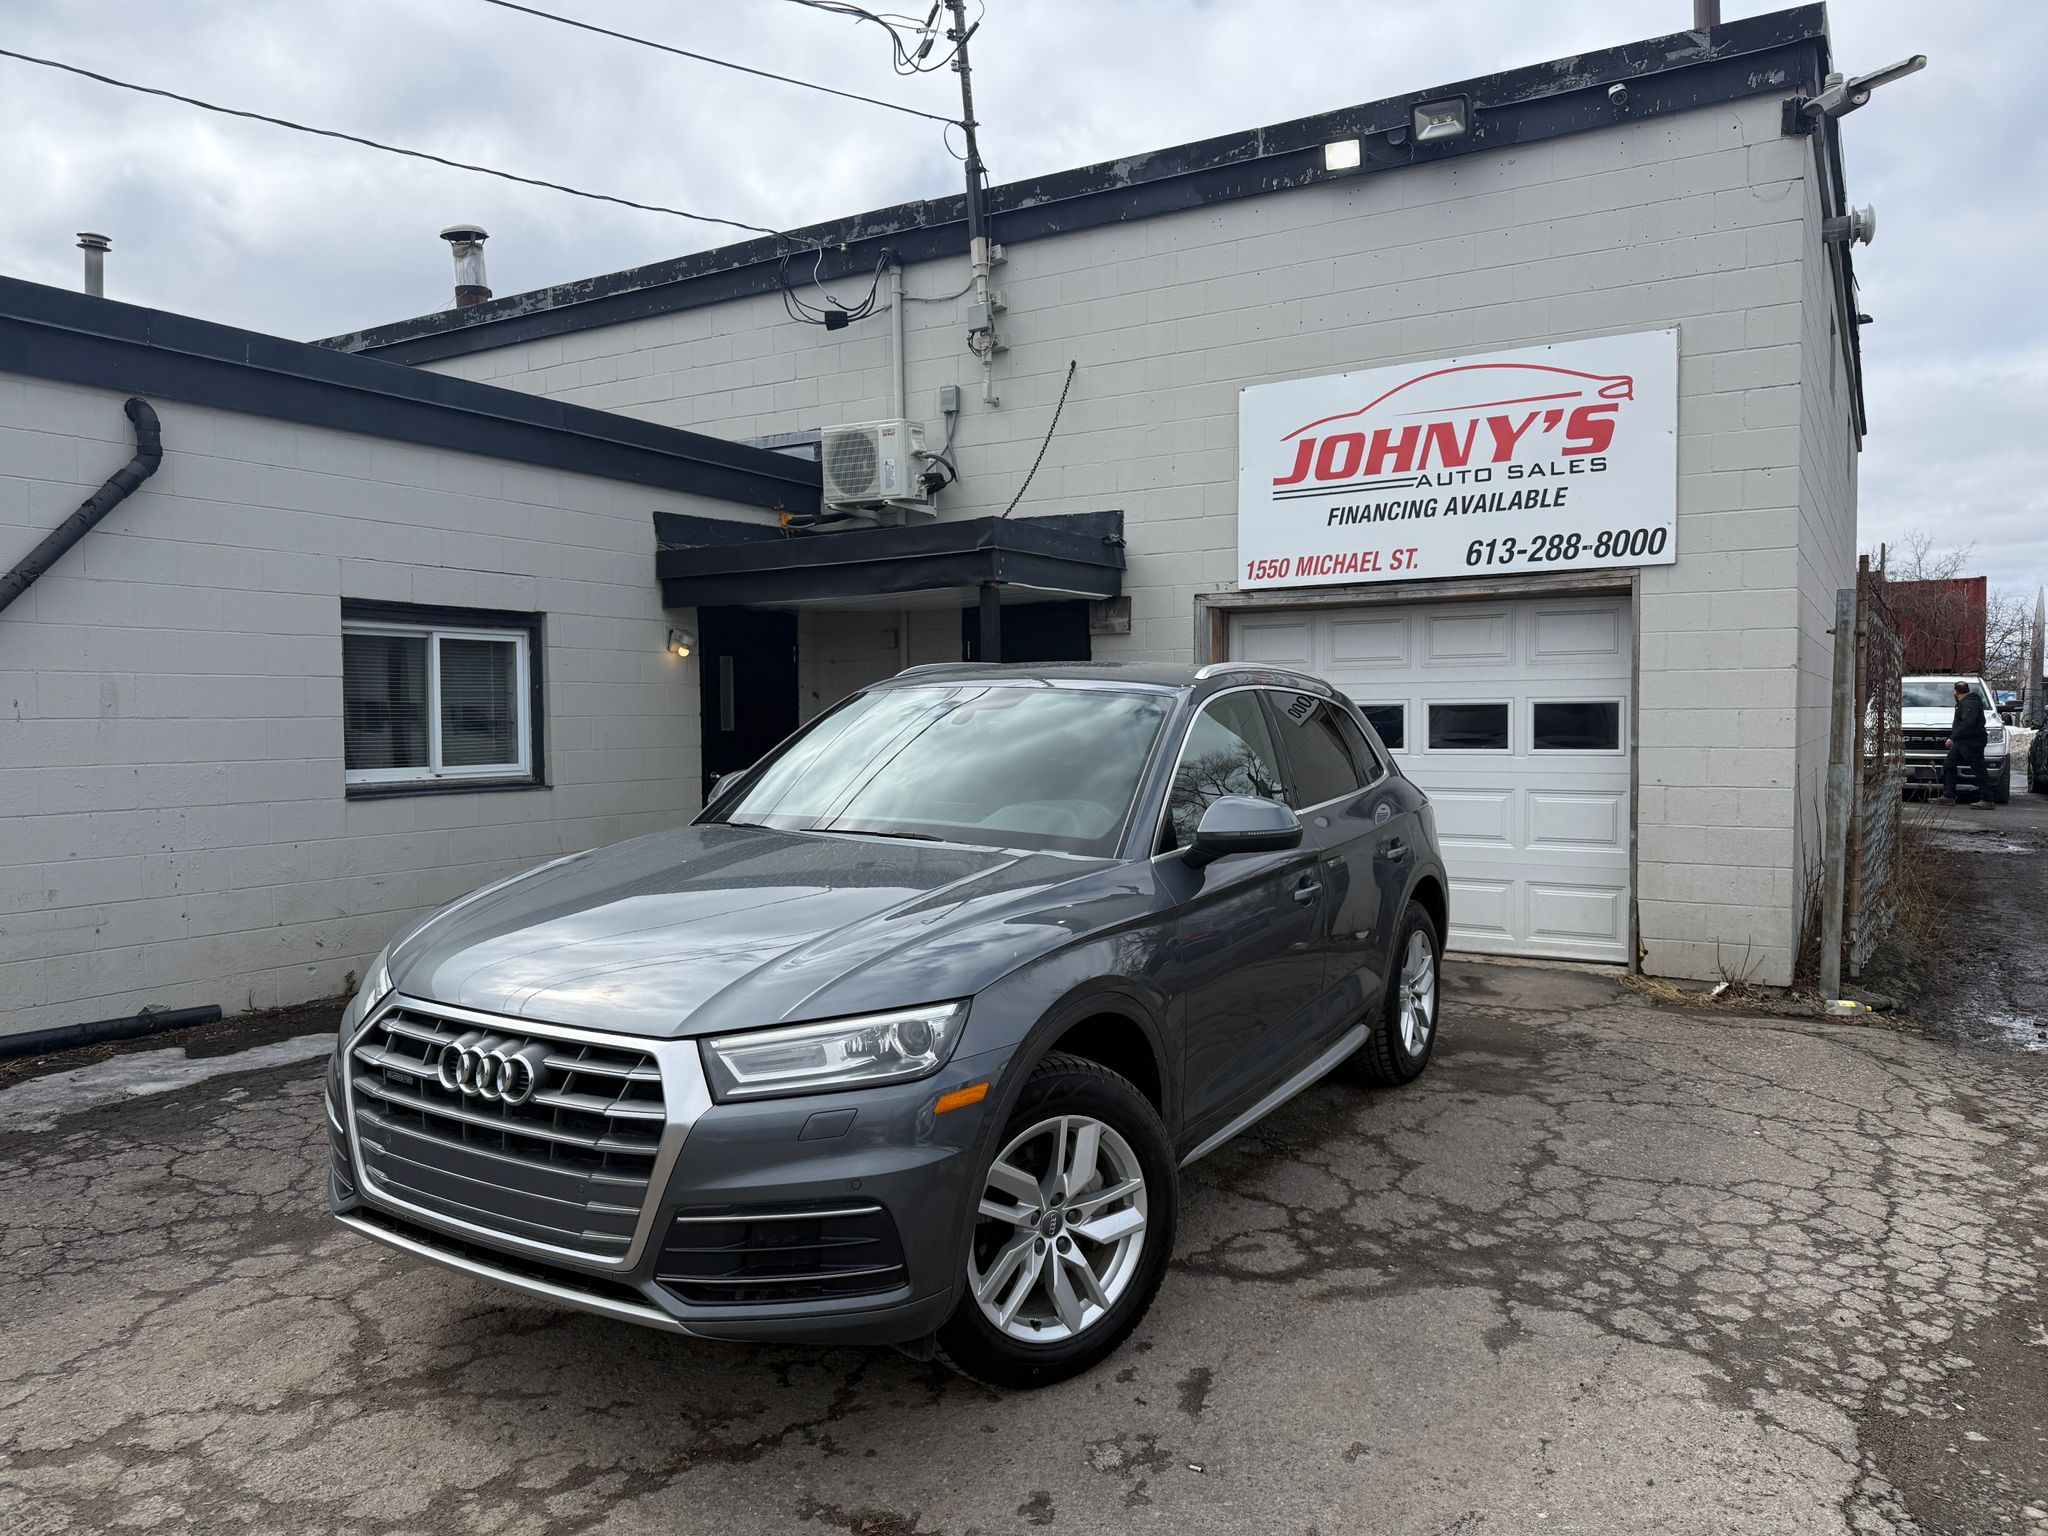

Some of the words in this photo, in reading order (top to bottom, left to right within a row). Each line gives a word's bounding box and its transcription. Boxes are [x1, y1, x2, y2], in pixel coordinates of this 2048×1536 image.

[1273, 402, 1619, 486] JOHNY'S
[1416, 467, 1492, 489] AUTO
[1507, 456, 1607, 480] SALES
[1327, 497, 1439, 526] FINANCING
[1443, 486, 1568, 516] AVAILABLE
[1247, 557, 1290, 580] 1550
[1295, 550, 1382, 577] MICHAEL
[1390, 547, 1419, 570] ST.
[1466, 527, 1668, 567] 613-288-8000
